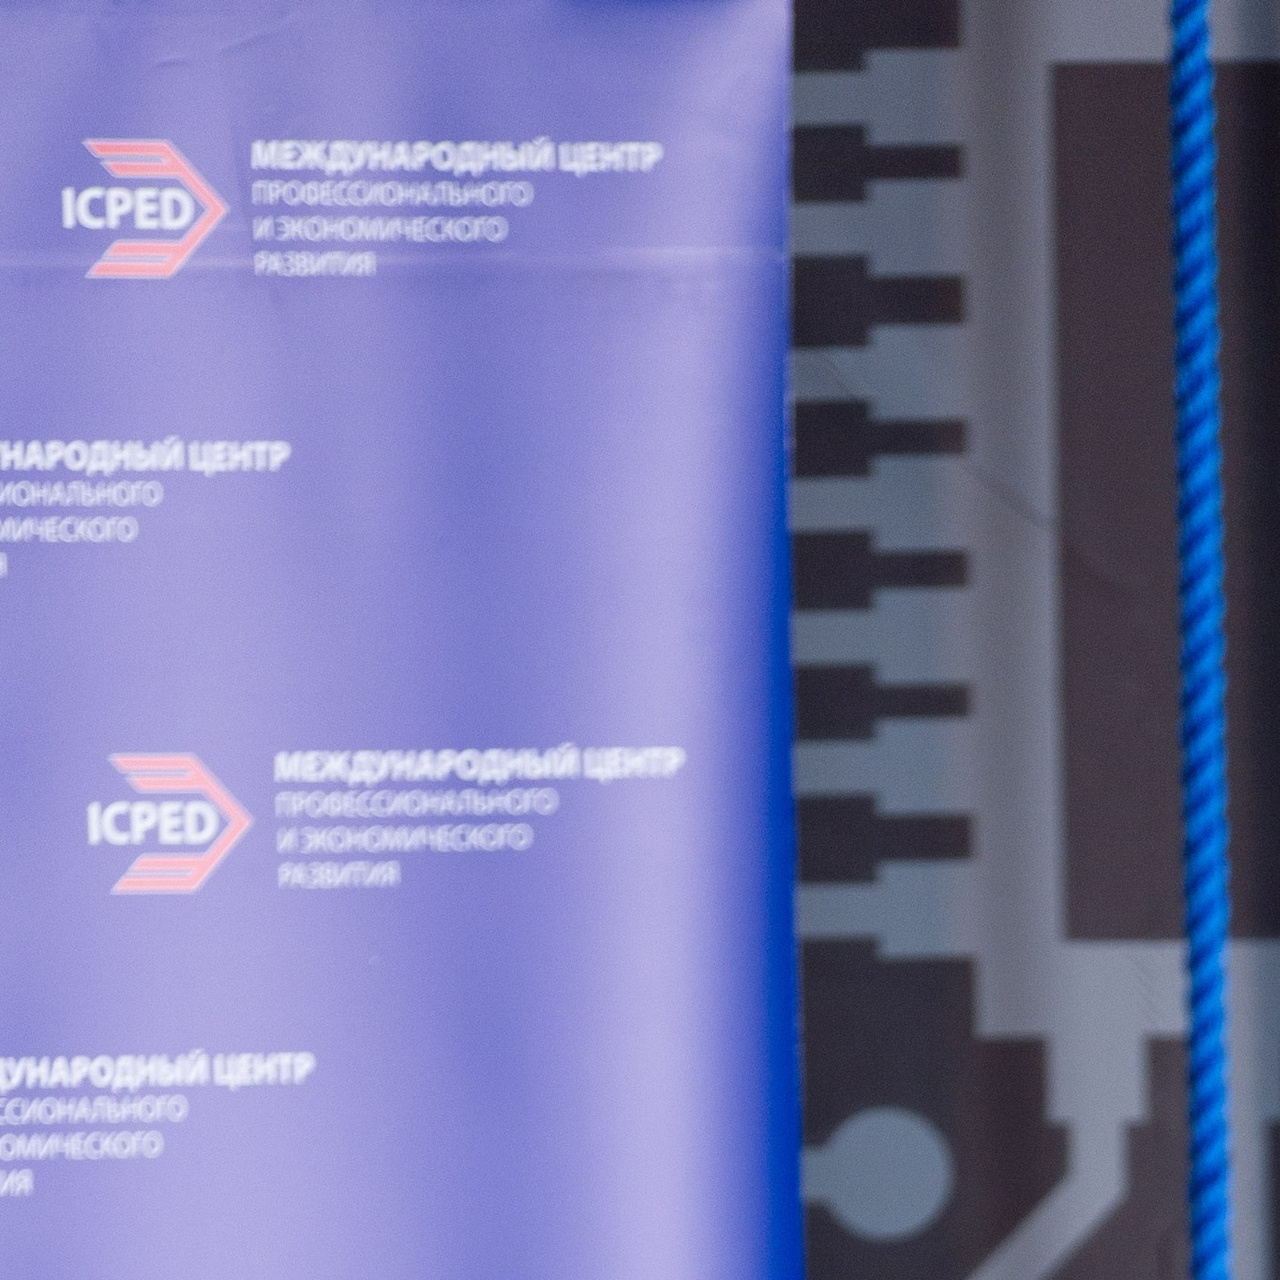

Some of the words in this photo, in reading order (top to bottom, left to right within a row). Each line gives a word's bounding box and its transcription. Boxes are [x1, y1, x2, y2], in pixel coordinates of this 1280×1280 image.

[251, 136, 555, 176] МЕЖДУНАРОДНЫЙ
[558, 142, 663, 177] ЦЕНТР
[61, 186, 195, 229] ICPED
[251, 180, 534, 207] ПРОФЕССИОНАЛЬНОГО
[253, 216, 274, 241] И
[276, 216, 509, 242] ЭКОНОМИЧЕСКОГО
[254, 251, 377, 276] РАЗВИТИЯ
[187, 440, 292, 478] ЦЕНТР
[274, 742, 581, 786] МЕЖДУНАРОДНЫЙ
[583, 746, 686, 784] ЦЕНТР
[274, 787, 560, 818] ПРОФЕССИОНАЛЬНОГО
[87, 800, 220, 846] ICPED
[277, 826, 298, 853] И
[301, 823, 534, 853] ЭКОНОМИЧЕСКОГО
[278, 859, 401, 889] РАЗВИТИЯ
[213, 1052, 316, 1092] ЦЕНТР
